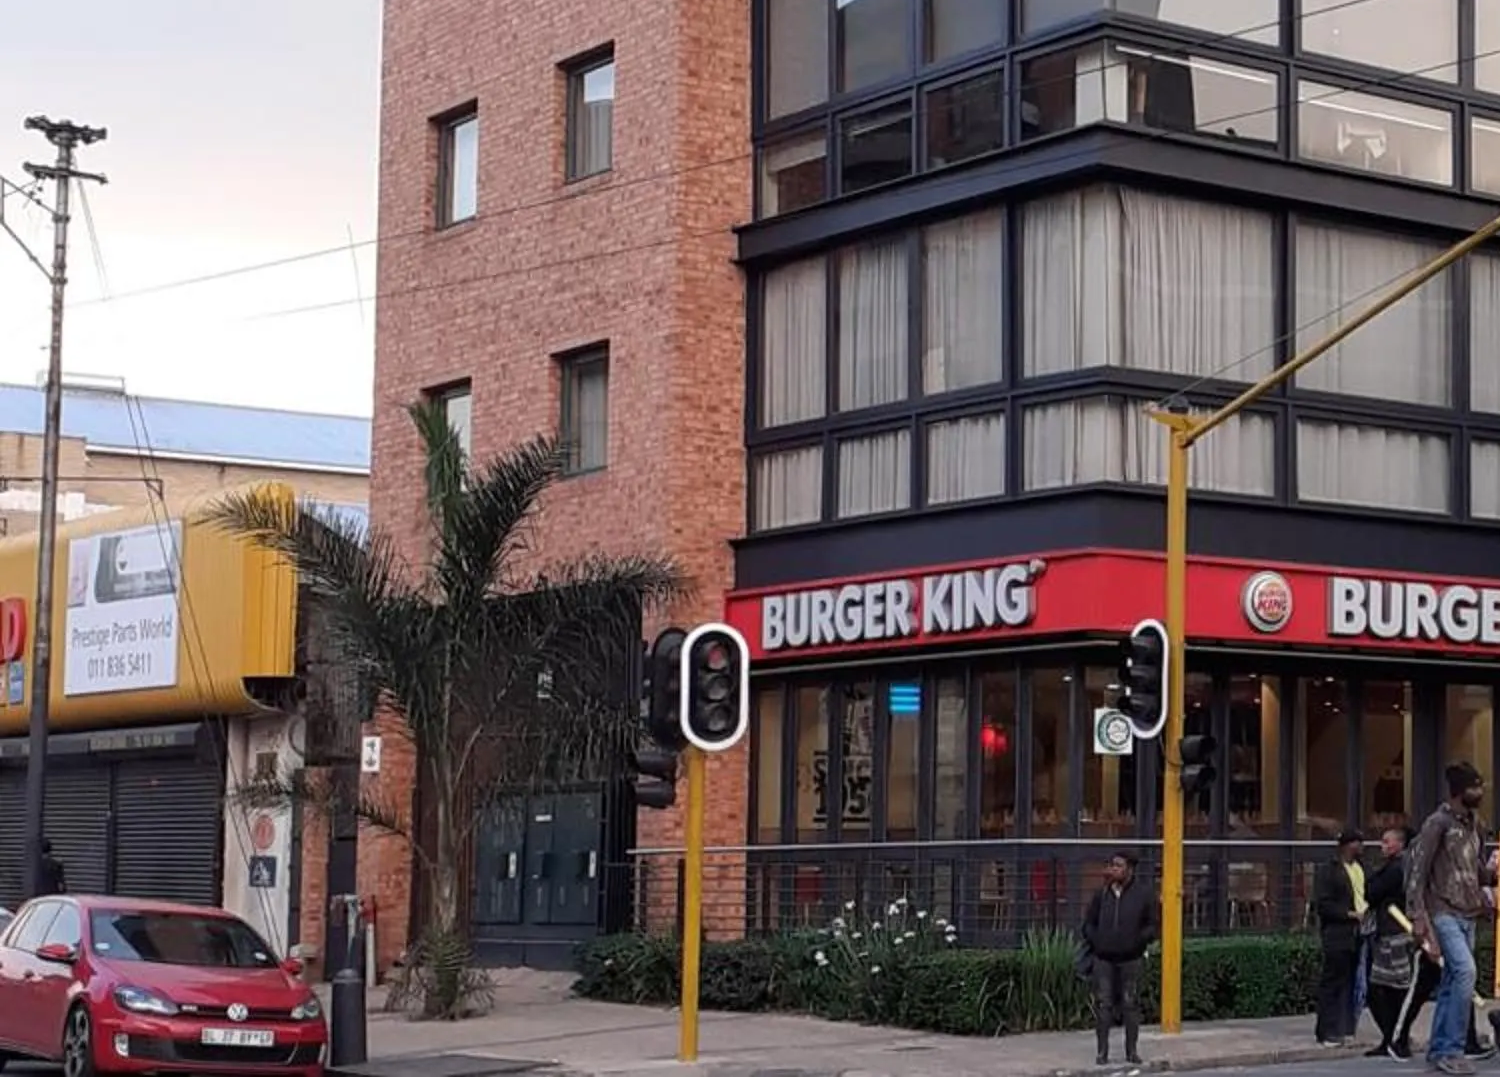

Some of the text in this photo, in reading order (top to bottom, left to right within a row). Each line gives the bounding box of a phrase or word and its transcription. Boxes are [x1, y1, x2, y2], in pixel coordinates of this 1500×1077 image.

[762, 564, 1031, 650] BURGER KING
[72, 615, 172, 651] Prestige Parts World
[87, 657, 105, 679] 011
